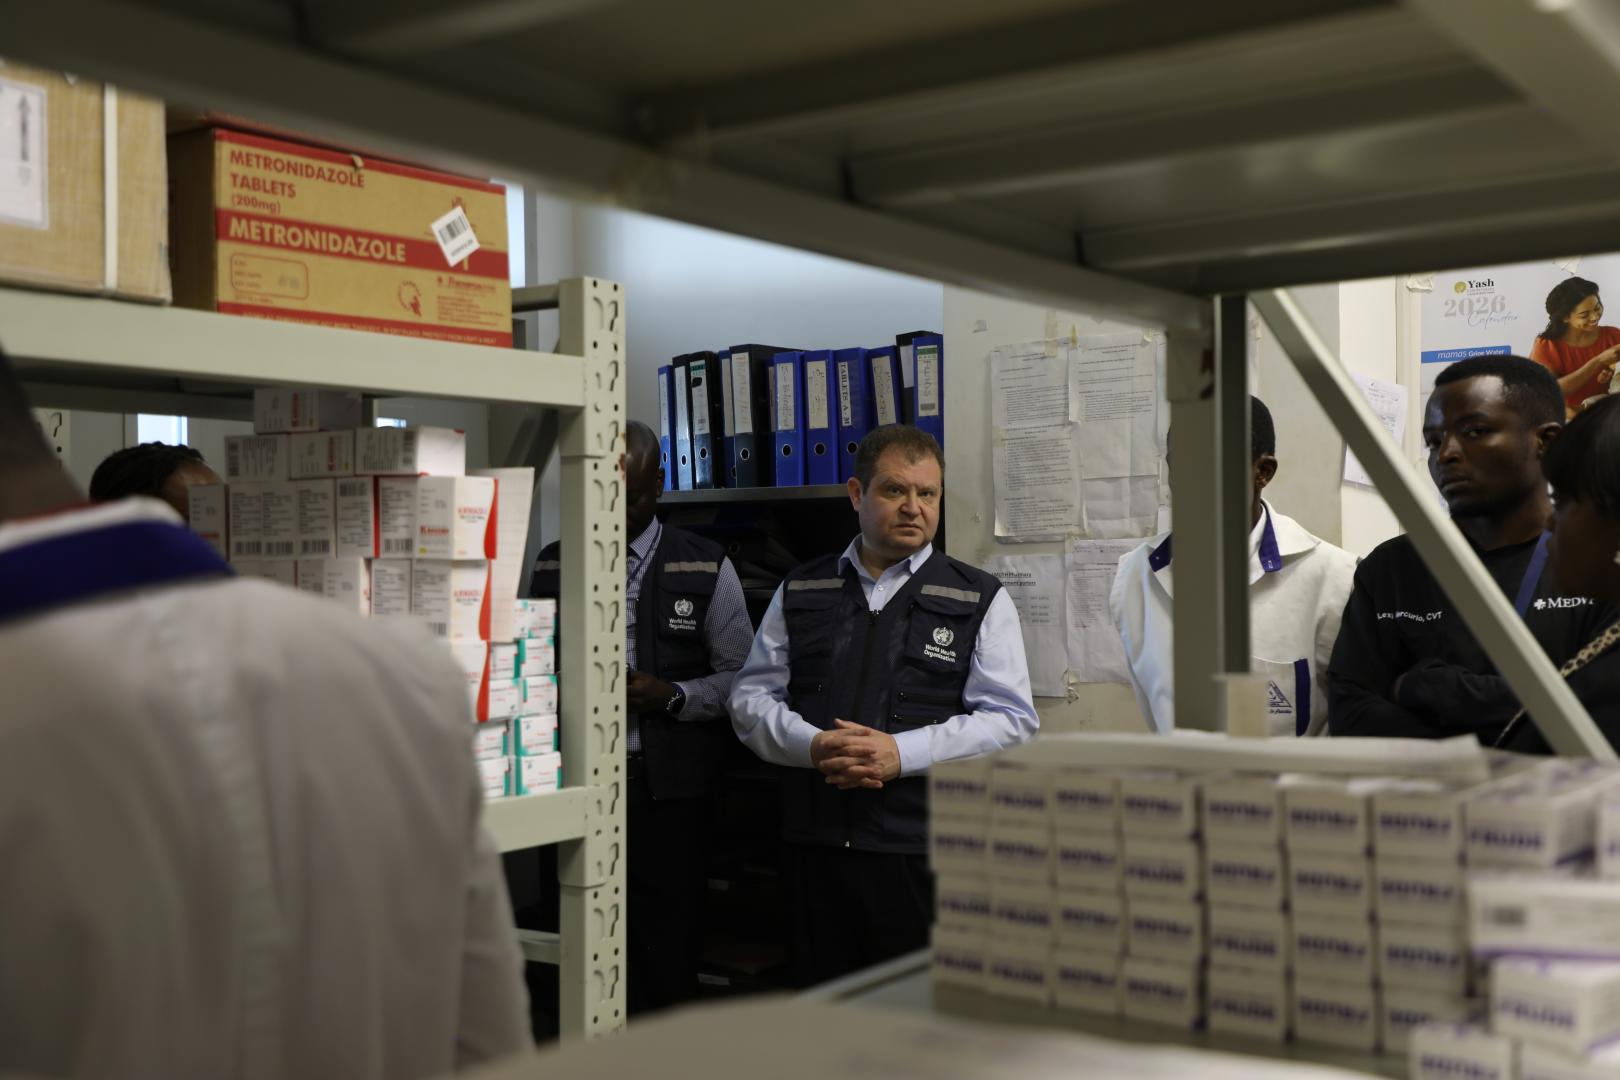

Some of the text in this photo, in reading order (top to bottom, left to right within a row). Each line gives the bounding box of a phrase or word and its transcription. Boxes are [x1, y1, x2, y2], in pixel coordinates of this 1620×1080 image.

[230, 150, 365, 188] METRONIDAZOLE
[230, 173, 296, 199] TABLETS
[232, 193, 281, 215] (200mg)
[229, 217, 406, 263] METRONIDAZOLE
[1467, 279, 1495, 288] Yash
[1444, 295, 1506, 317] 2026
[1437, 351, 1467, 359] mamas
[1426, 611, 1442, 621] CVT
[924, 649, 955, 663] Organization
[925, 644, 956, 657] World Health
